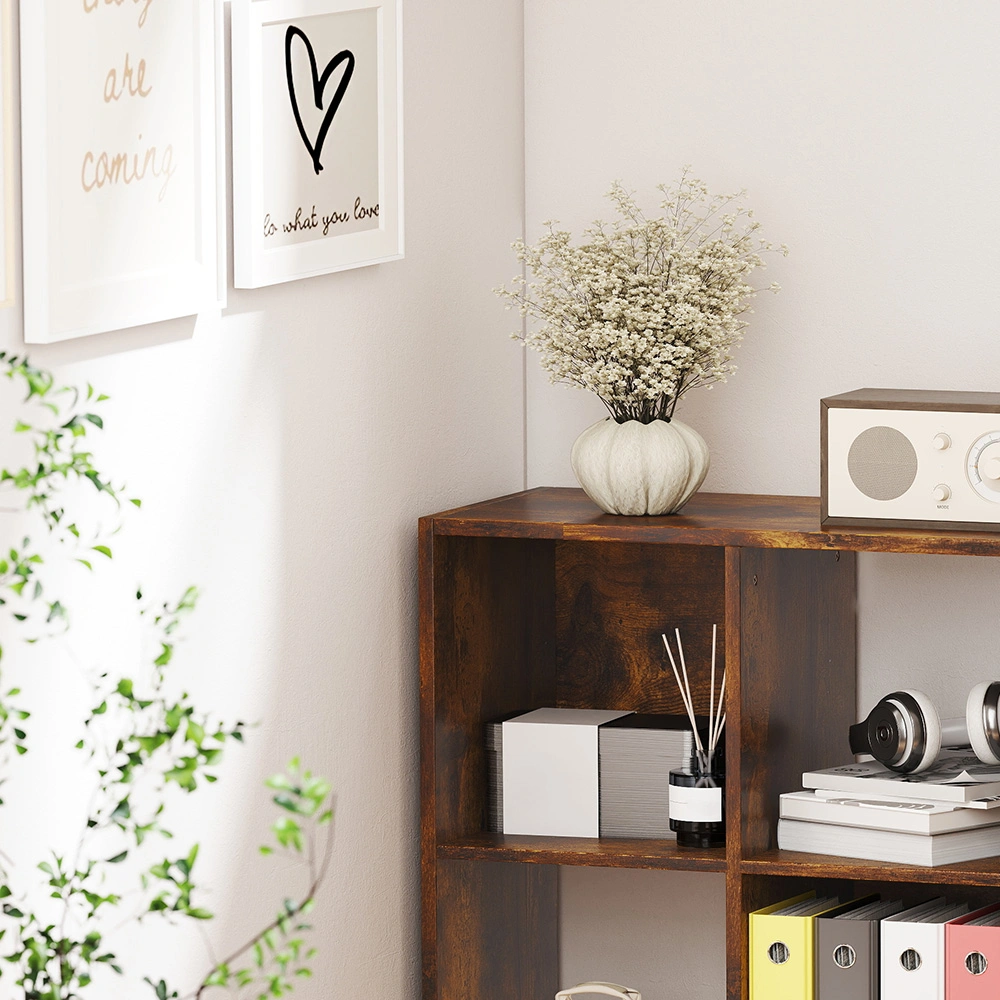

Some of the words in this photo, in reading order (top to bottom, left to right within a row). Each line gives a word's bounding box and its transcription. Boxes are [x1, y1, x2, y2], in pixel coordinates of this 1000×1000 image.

[81, 133, 178, 203] coming
[283, 205, 318, 233] what
[322, 211, 350, 236] you
[353, 196, 379, 220] love
